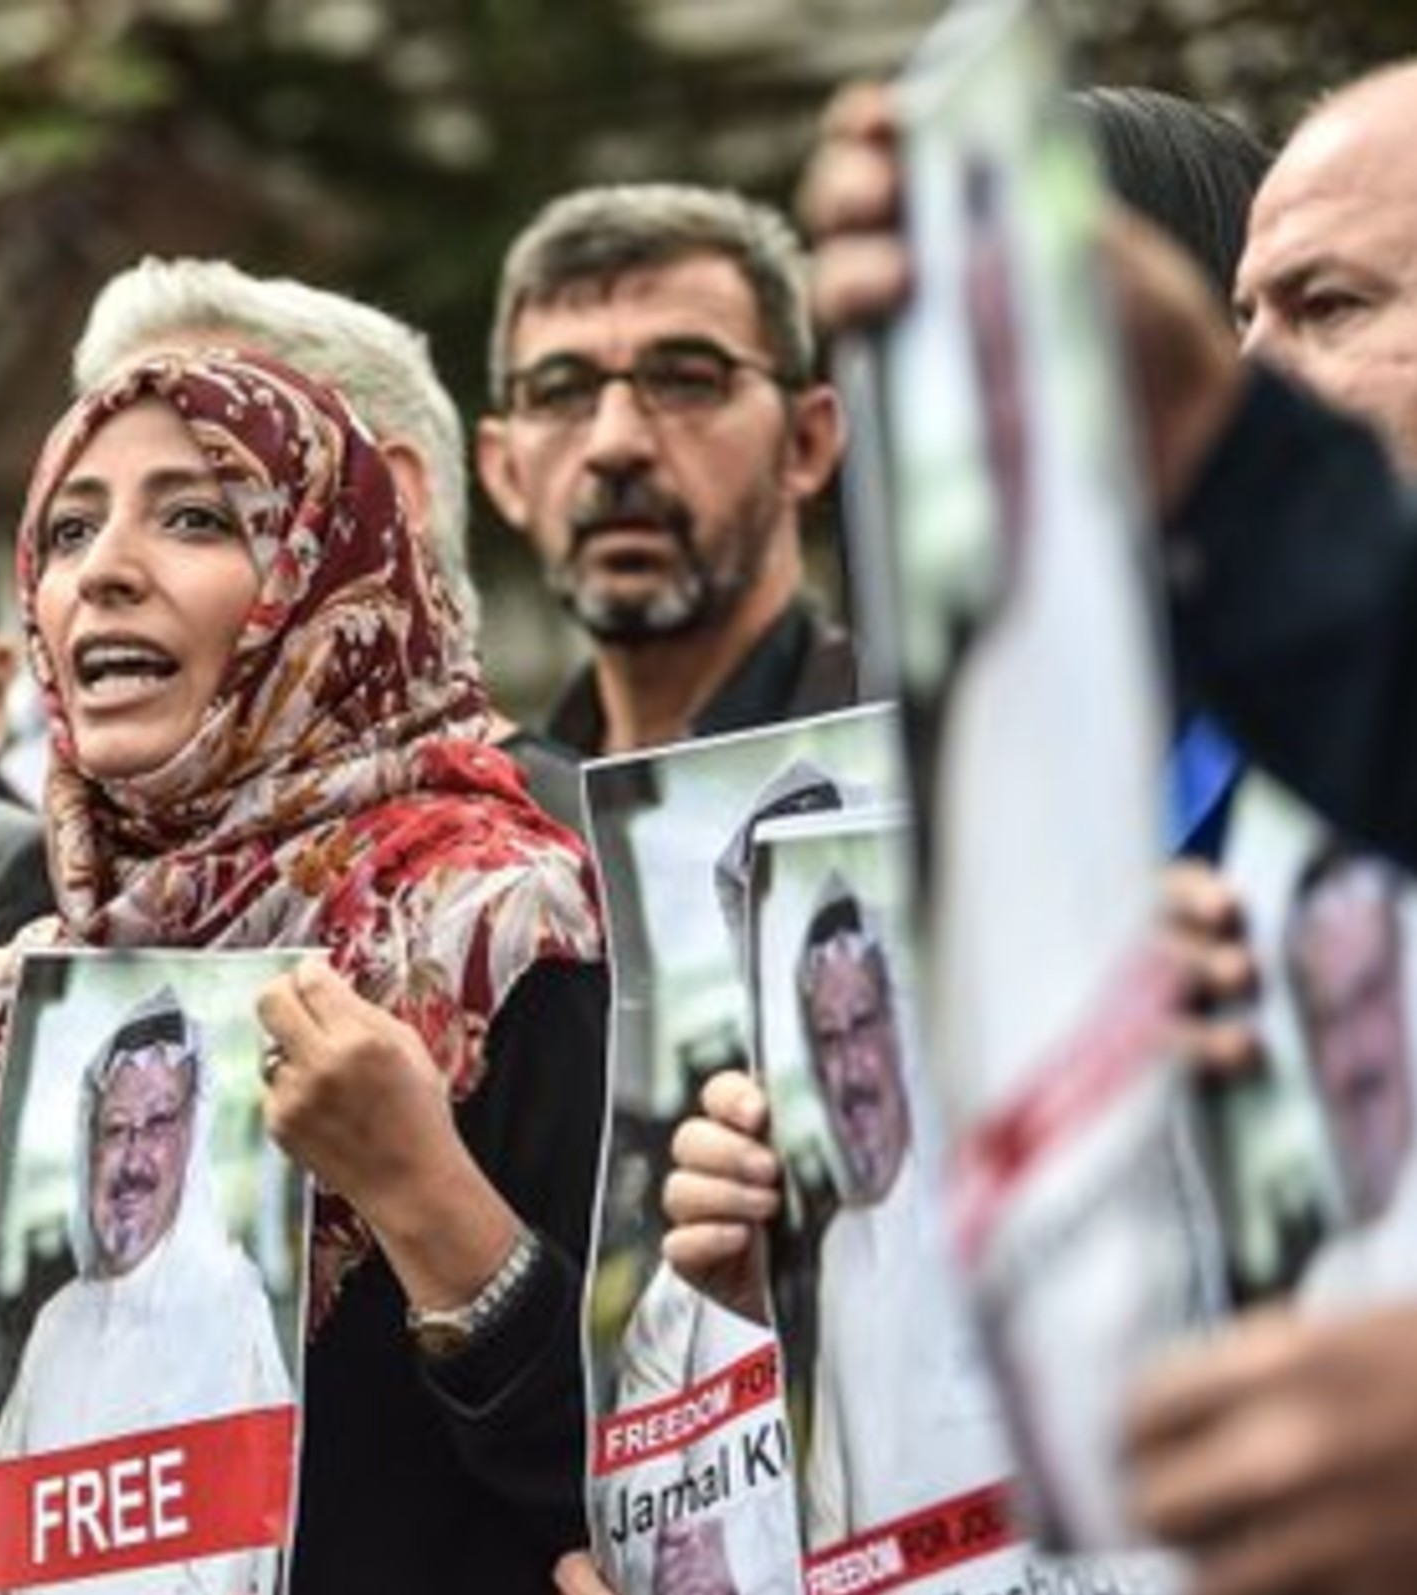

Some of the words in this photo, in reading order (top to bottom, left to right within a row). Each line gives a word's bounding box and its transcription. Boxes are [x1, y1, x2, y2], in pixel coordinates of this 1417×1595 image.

[605, 1379, 731, 1460] FREEDOM
[32, 1448, 188, 1565] FREE
[610, 1442, 731, 1544] Jamal
